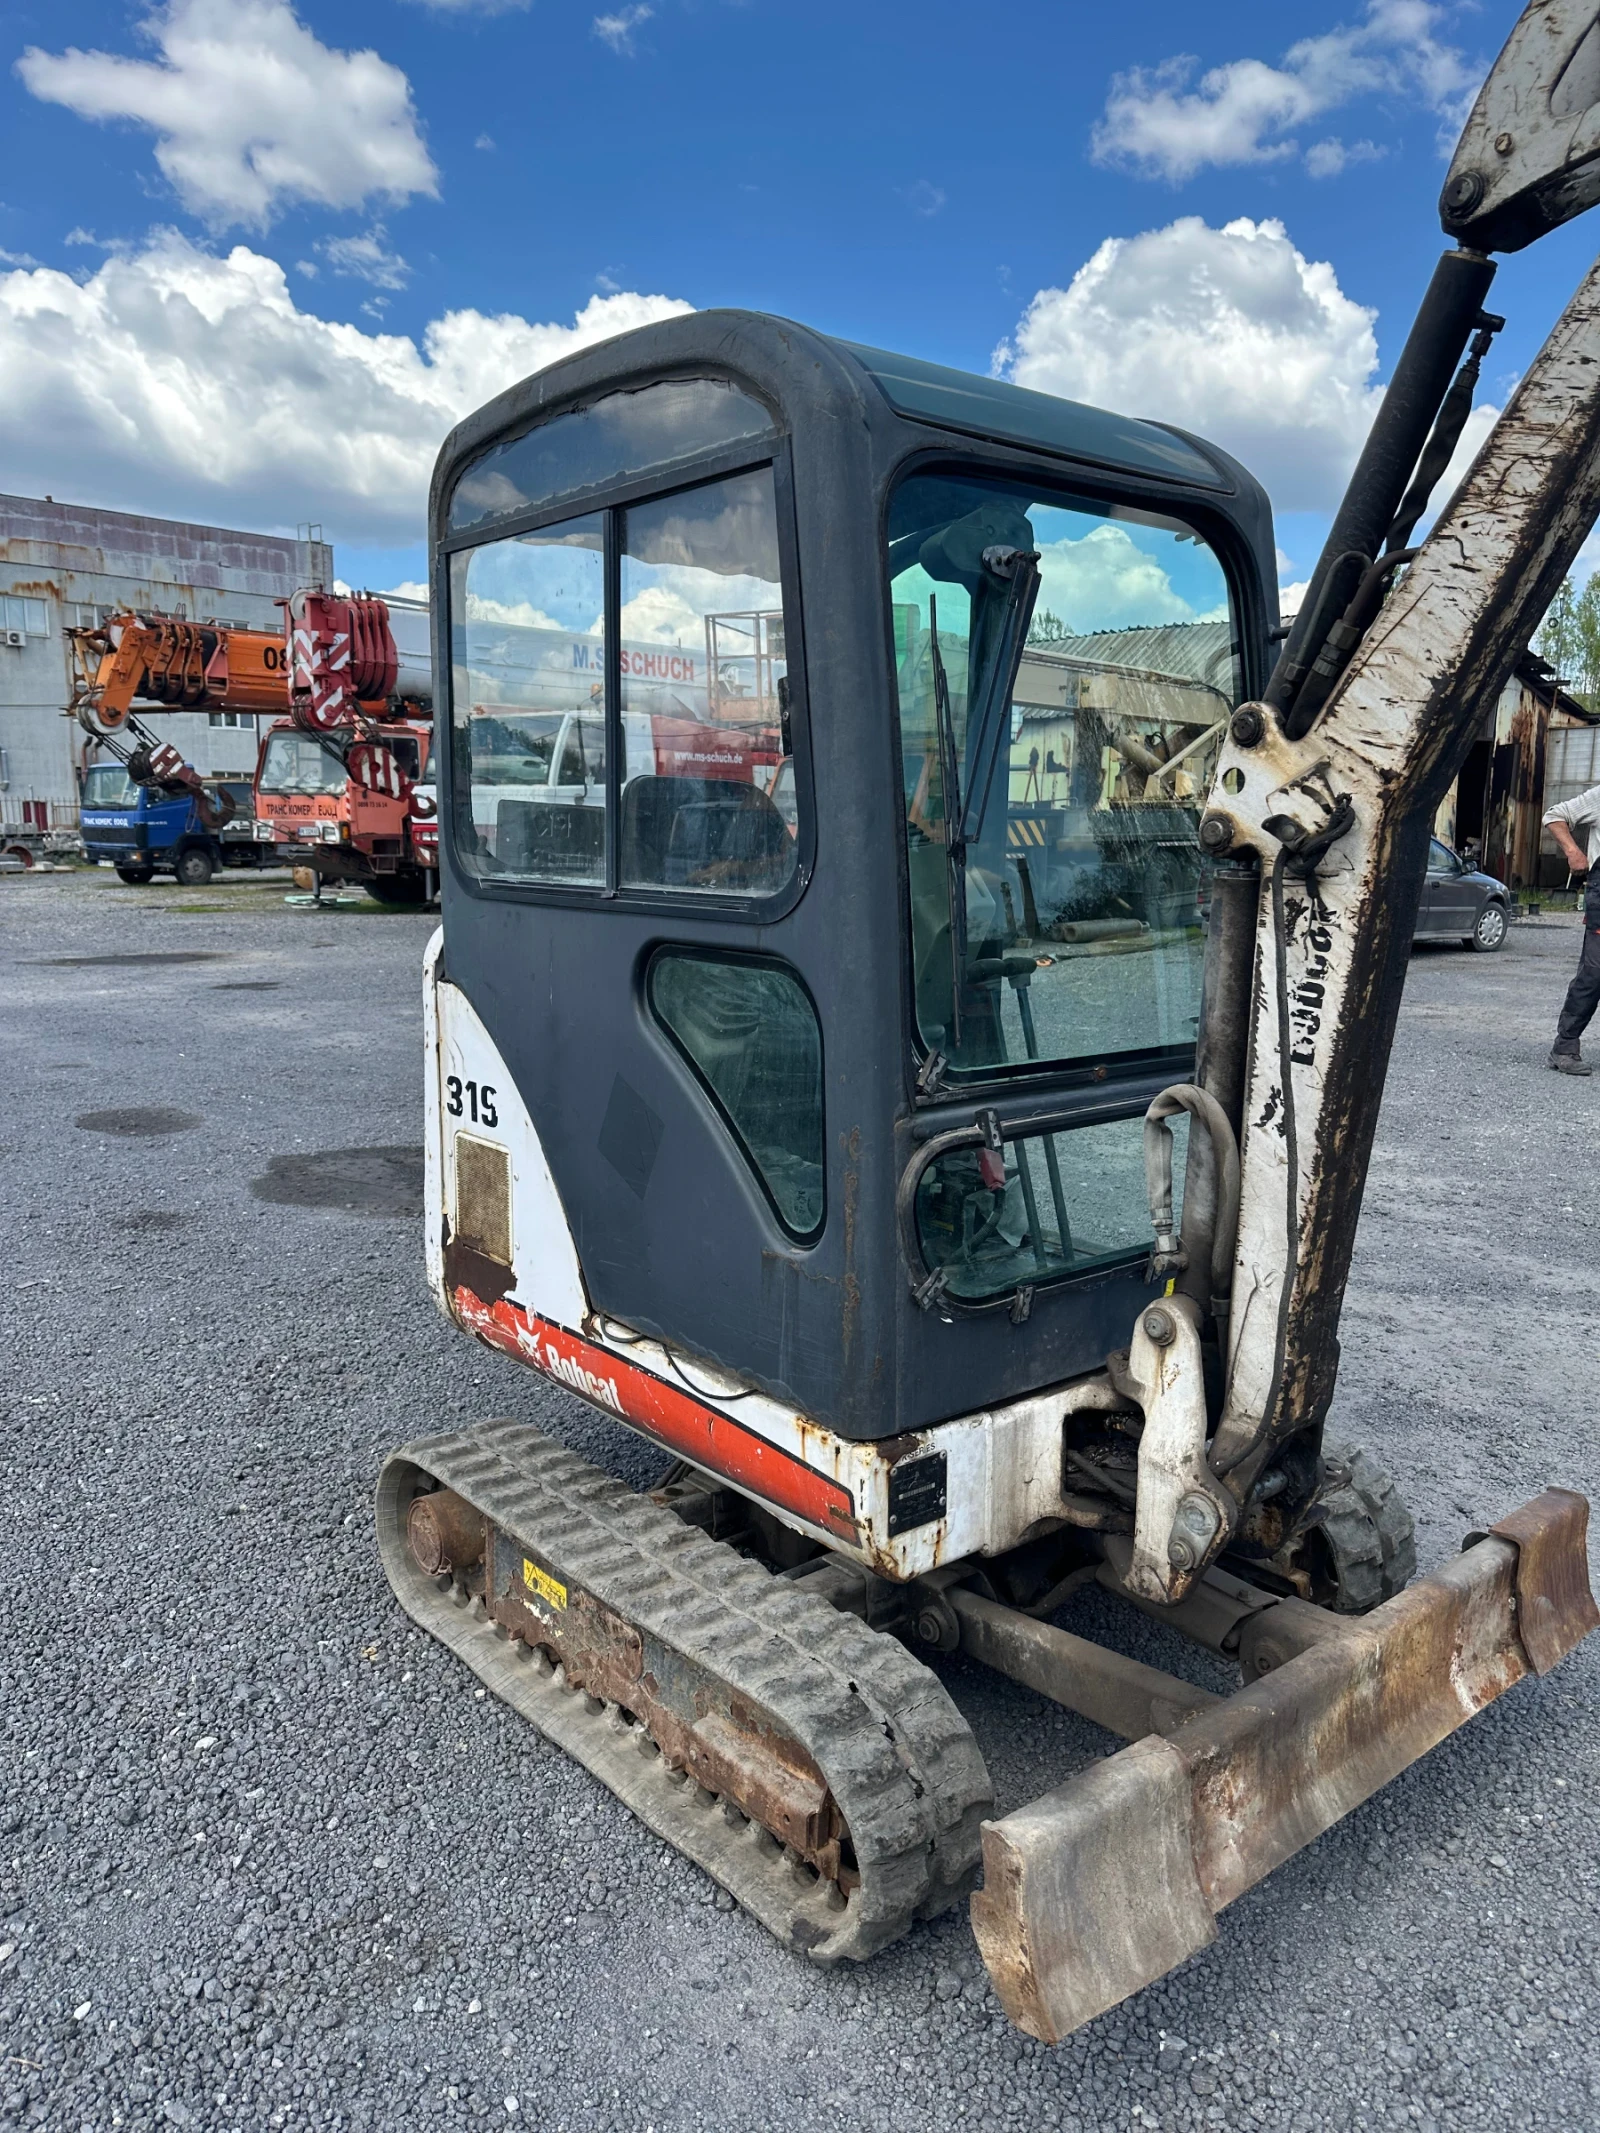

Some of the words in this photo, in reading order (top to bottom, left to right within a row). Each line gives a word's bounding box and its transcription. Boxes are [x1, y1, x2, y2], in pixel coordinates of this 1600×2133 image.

[620, 650, 694, 680] SCHUCH
[674, 751, 743, 763] www.ms-schuch.de
[266, 804, 287, 815] ТРАНС
[545, 1343, 628, 1415] Bobcat
